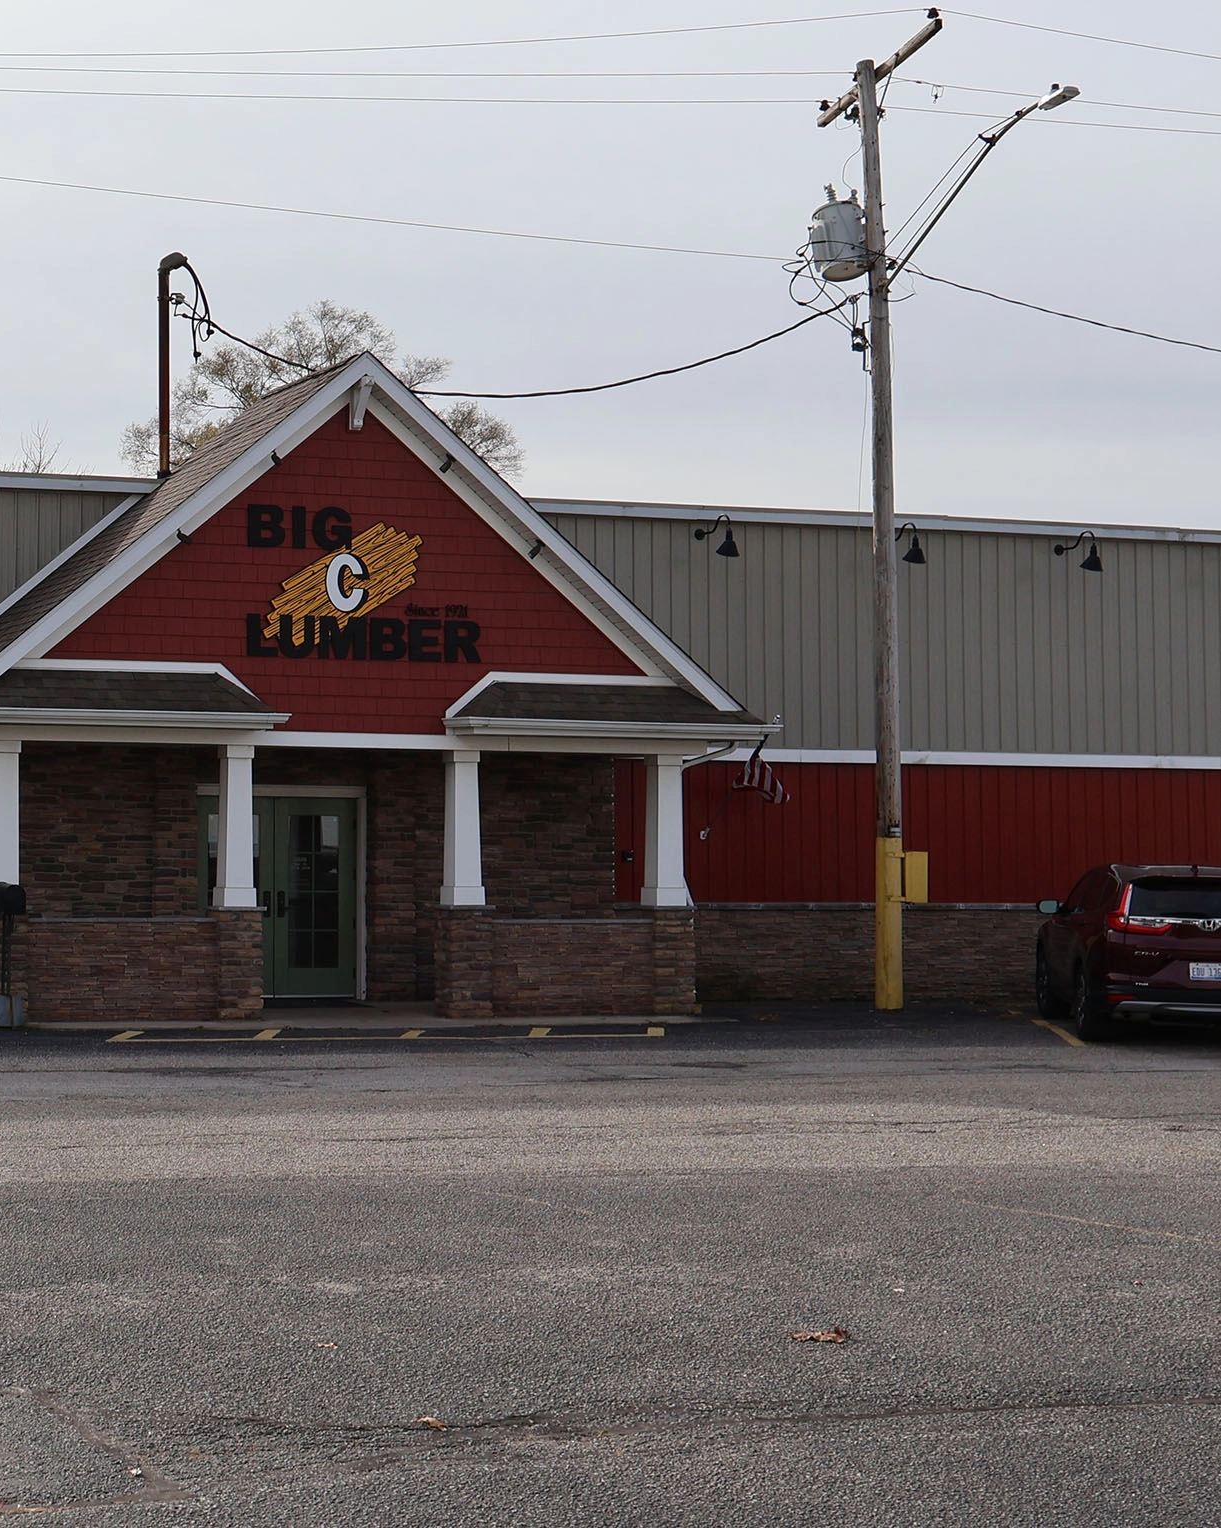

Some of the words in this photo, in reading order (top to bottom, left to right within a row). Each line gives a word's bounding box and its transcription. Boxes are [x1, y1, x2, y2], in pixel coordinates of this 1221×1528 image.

[247, 503, 353, 550] BIG
[325, 553, 370, 613] C
[246, 613, 482, 664] LUMBER
